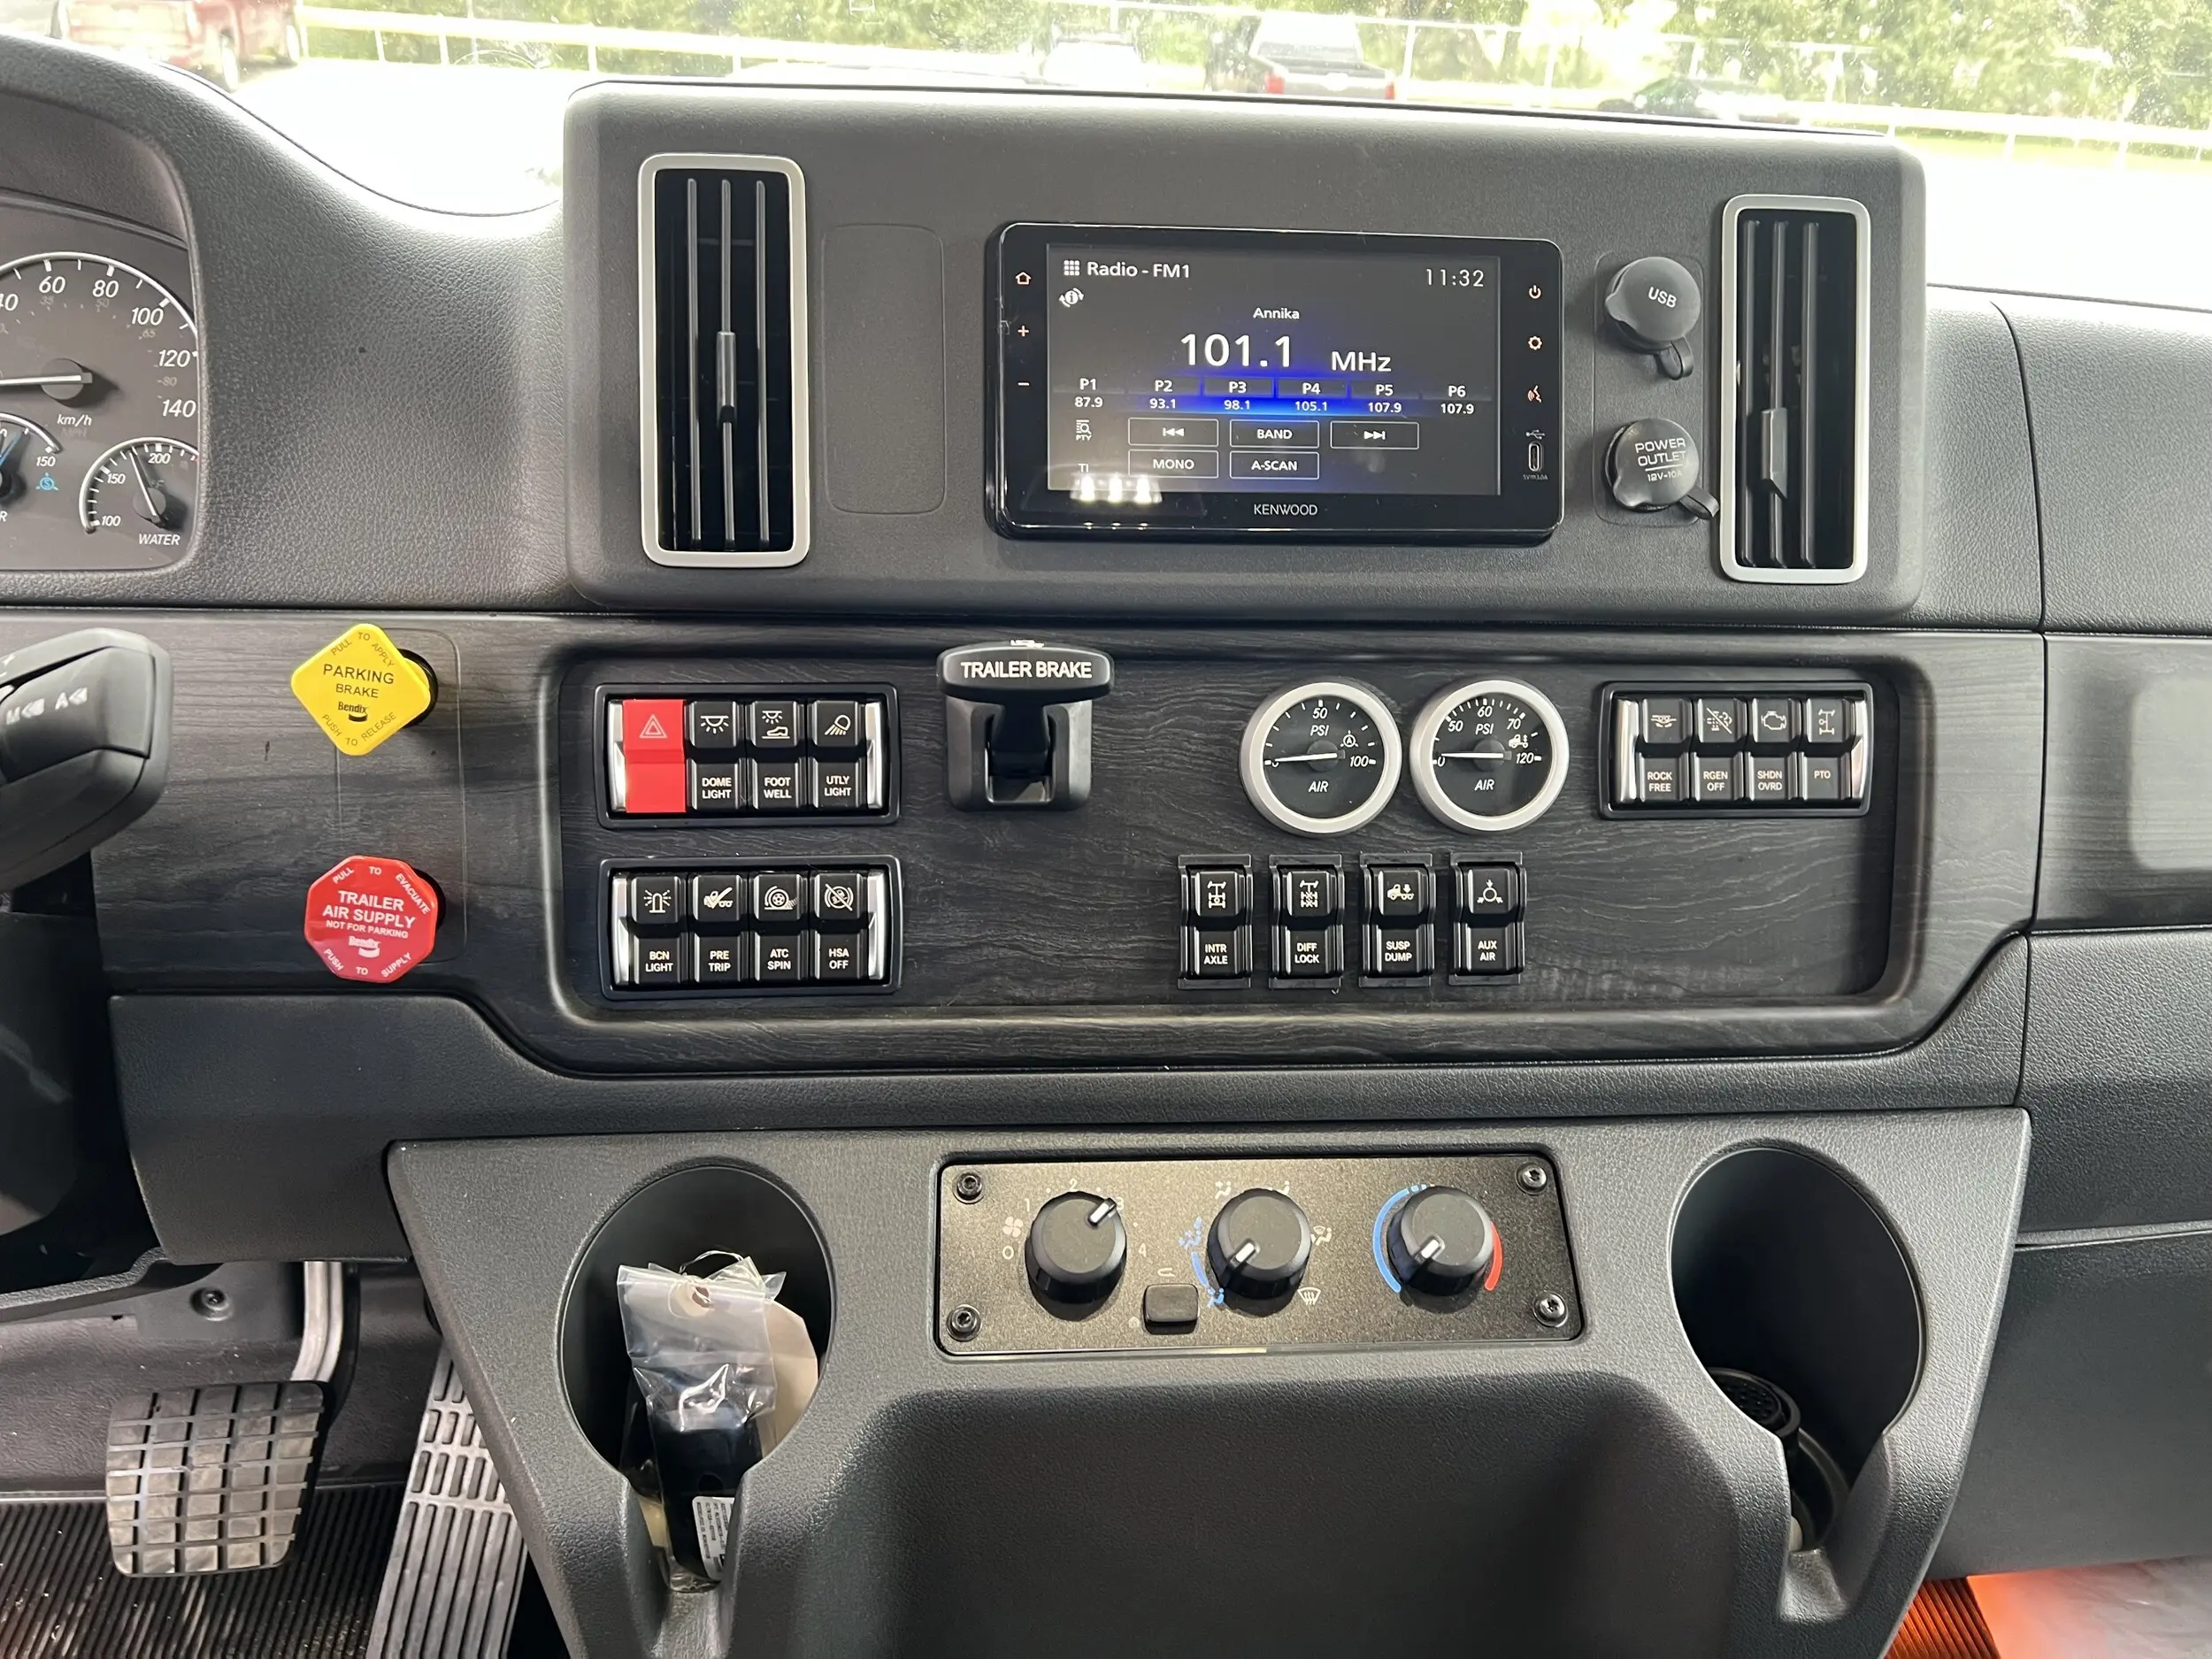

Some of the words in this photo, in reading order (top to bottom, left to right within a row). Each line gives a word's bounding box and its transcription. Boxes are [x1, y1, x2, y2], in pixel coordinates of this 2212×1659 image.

[1087, 261, 1138, 276] Radio
[1153, 264, 1190, 278] FM1
[1426, 269, 1485, 287] 11:32
[39, 276, 65, 294] 60
[92, 280, 118, 297] 80
[1647, 287, 1678, 308] USB
[131, 307, 164, 326] 100
[1253, 308, 1300, 319] Annika
[159, 349, 191, 368] 120
[1180, 333, 1291, 367] 101.1
[1331, 351, 1392, 372] MHz
[1079, 378, 1096, 391] P1
[1155, 380, 1173, 393] P2
[1228, 381, 1248, 394] P3
[1302, 382, 1321, 395] P4
[1375, 384, 1394, 396] P5
[1448, 386, 1466, 398] P6
[163, 398, 196, 418] 140
[1074, 396, 1103, 409] 87.9
[1150, 398, 1176, 409] 93.1
[1224, 400, 1250, 411] 98.1
[1295, 402, 1327, 411] 105.1
[1368, 402, 1402, 413] 107.9
[1440, 403, 1474, 414] 107.9
[57, 414, 92, 426] km/h
[1256, 429, 1293, 440] BAND
[1635, 437, 1686, 453] POWER
[35, 457, 56, 467] 150
[148, 453, 172, 464] 200
[1152, 458, 1194, 470] MONO
[1638, 450, 1686, 467] OUTLET
[1251, 460, 1298, 471] A-SCAN
[107, 473, 126, 485] 150
[1253, 504, 1318, 517] KENWOOD
[101, 515, 121, 526] 100
[138, 533, 180, 545] WATER
[331, 639, 352, 656] PULL
[357, 632, 370, 641] TO
[372, 642, 395, 667] APPLY
[323, 664, 395, 685] PARKING
[961, 661, 1033, 678] TRAILER
[1035, 662, 1093, 679] BRAKE
[336, 683, 380, 699] BRAKE
[338, 701, 367, 714] Bendix
[1312, 708, 1327, 719] 50
[1478, 706, 1493, 718] 60
[322, 713, 342, 737] PUSH
[345, 737, 358, 747] TO
[361, 711, 397, 741] RELEASE
[1448, 720, 1463, 733] 50
[1475, 724, 1494, 734] PSI
[1507, 718, 1522, 730] 70
[1310, 726, 1329, 736] PSI
[1349, 756, 1370, 768] 100
[1517, 752, 1534, 764] 120
[826, 775, 849, 786] UTLY
[1647, 772, 1672, 781] ROCK
[1703, 770, 1728, 780] RGEN
[1757, 770, 1782, 780] SHDN
[1814, 770, 1832, 780] PTO
[703, 777, 732, 787] DOME
[764, 777, 791, 787] FOOT
[1308, 780, 1329, 793] AIR
[1474, 779, 1495, 791] AIR
[1649, 782, 1671, 793] FREE
[1707, 782, 1725, 791] OFF
[1757, 780, 1782, 791] OVRD
[703, 789, 732, 799] LIGHT
[764, 789, 792, 799] WELL
[825, 787, 851, 796] LIGHT
[333, 867, 355, 884] PULL
[368, 865, 382, 876] TO
[395, 872, 432, 915] EVACUATE
[338, 890, 404, 911] TRAILER
[322, 904, 350, 920] AIR
[352, 909, 416, 929] SUPPLY
[326, 920, 347, 929] NOT
[347, 922, 366, 933] FOR
[368, 926, 409, 939] PARKING
[1204, 943, 1227, 954] INTR
[1297, 943, 1317, 953] DIFF
[1386, 941, 1410, 951] SUSP
[1478, 940, 1497, 950] AUX
[649, 950, 670, 961] BCN
[710, 950, 729, 961] PRE
[770, 948, 789, 958] ATC
[828, 948, 849, 957] HSA
[1385, 952, 1412, 963] DUMP
[1479, 951, 1495, 962] AIR
[324, 949, 344, 972] PUSH
[356, 966, 368, 976] TO
[380, 952, 412, 978] SUPPLY
[829, 959, 849, 970] OFF
[1203, 954, 1228, 965] AXLE
[1294, 954, 1320, 964] LOCK
[646, 963, 673, 972] LIGHT
[708, 962, 731, 972] TRIP
[768, 960, 791, 971] SPIN
[1069, 1177, 1079, 1192] 2
[1024, 1198, 1030, 1212] 1
[1138, 1242, 1147, 1257] 4
